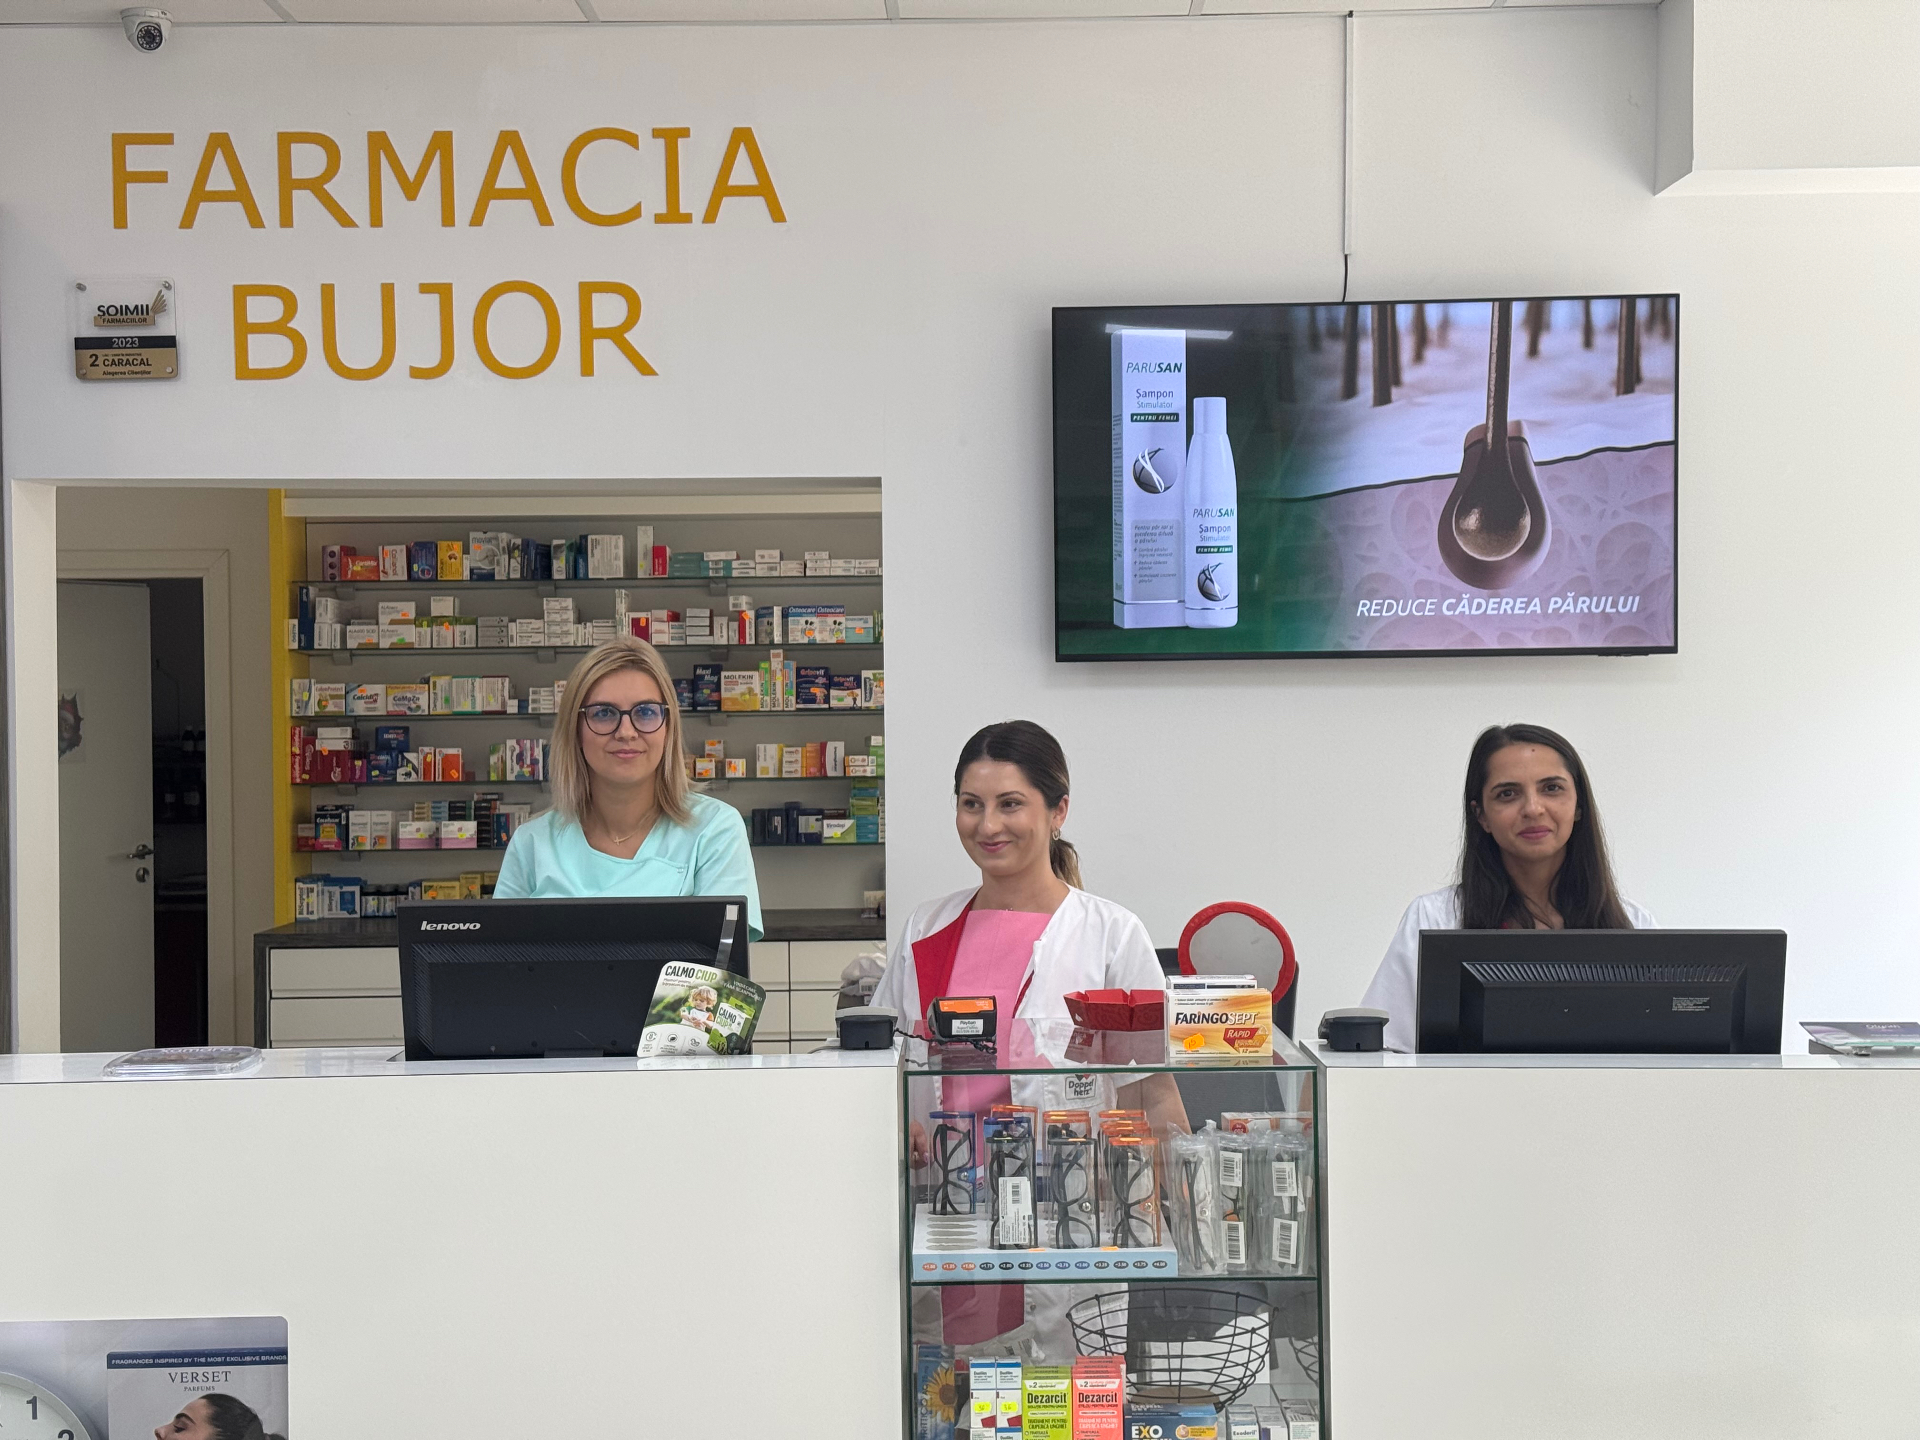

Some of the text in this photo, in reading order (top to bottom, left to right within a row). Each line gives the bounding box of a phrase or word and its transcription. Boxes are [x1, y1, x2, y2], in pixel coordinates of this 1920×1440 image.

[111, 126, 788, 229] FARMACIA
[232, 280, 659, 381] BUJOR
[112, 337, 139, 348] 2023
[89, 354, 152, 367] 2 CARACAL
[1126, 362, 1182, 373] PARUSAN
[1136, 401, 1173, 409] Stimulator
[1193, 508, 1234, 518] PARUSAN
[1356, 592, 1641, 617] REDUCE CĂDEREA PĂRULUI
[420, 920, 481, 931] lenovo
[665, 965, 718, 983] CALMO CIUP
[718, 1007, 737, 1023] CALMO
[1175, 1011, 1257, 1025] FARINGOSEPT
[1226, 1030, 1251, 1038] RAPID
[1069, 1079, 1094, 1089] Doppel
[1074, 1088, 1090, 1096] herz
[168, 1371, 231, 1383] VERSET
[1027, 1392, 1067, 1404] Dezarcit
[1078, 1391, 1118, 1403] Dezarcit
[26, 1396, 38, 1420] 1
[1131, 1425, 1163, 1439] EXO
